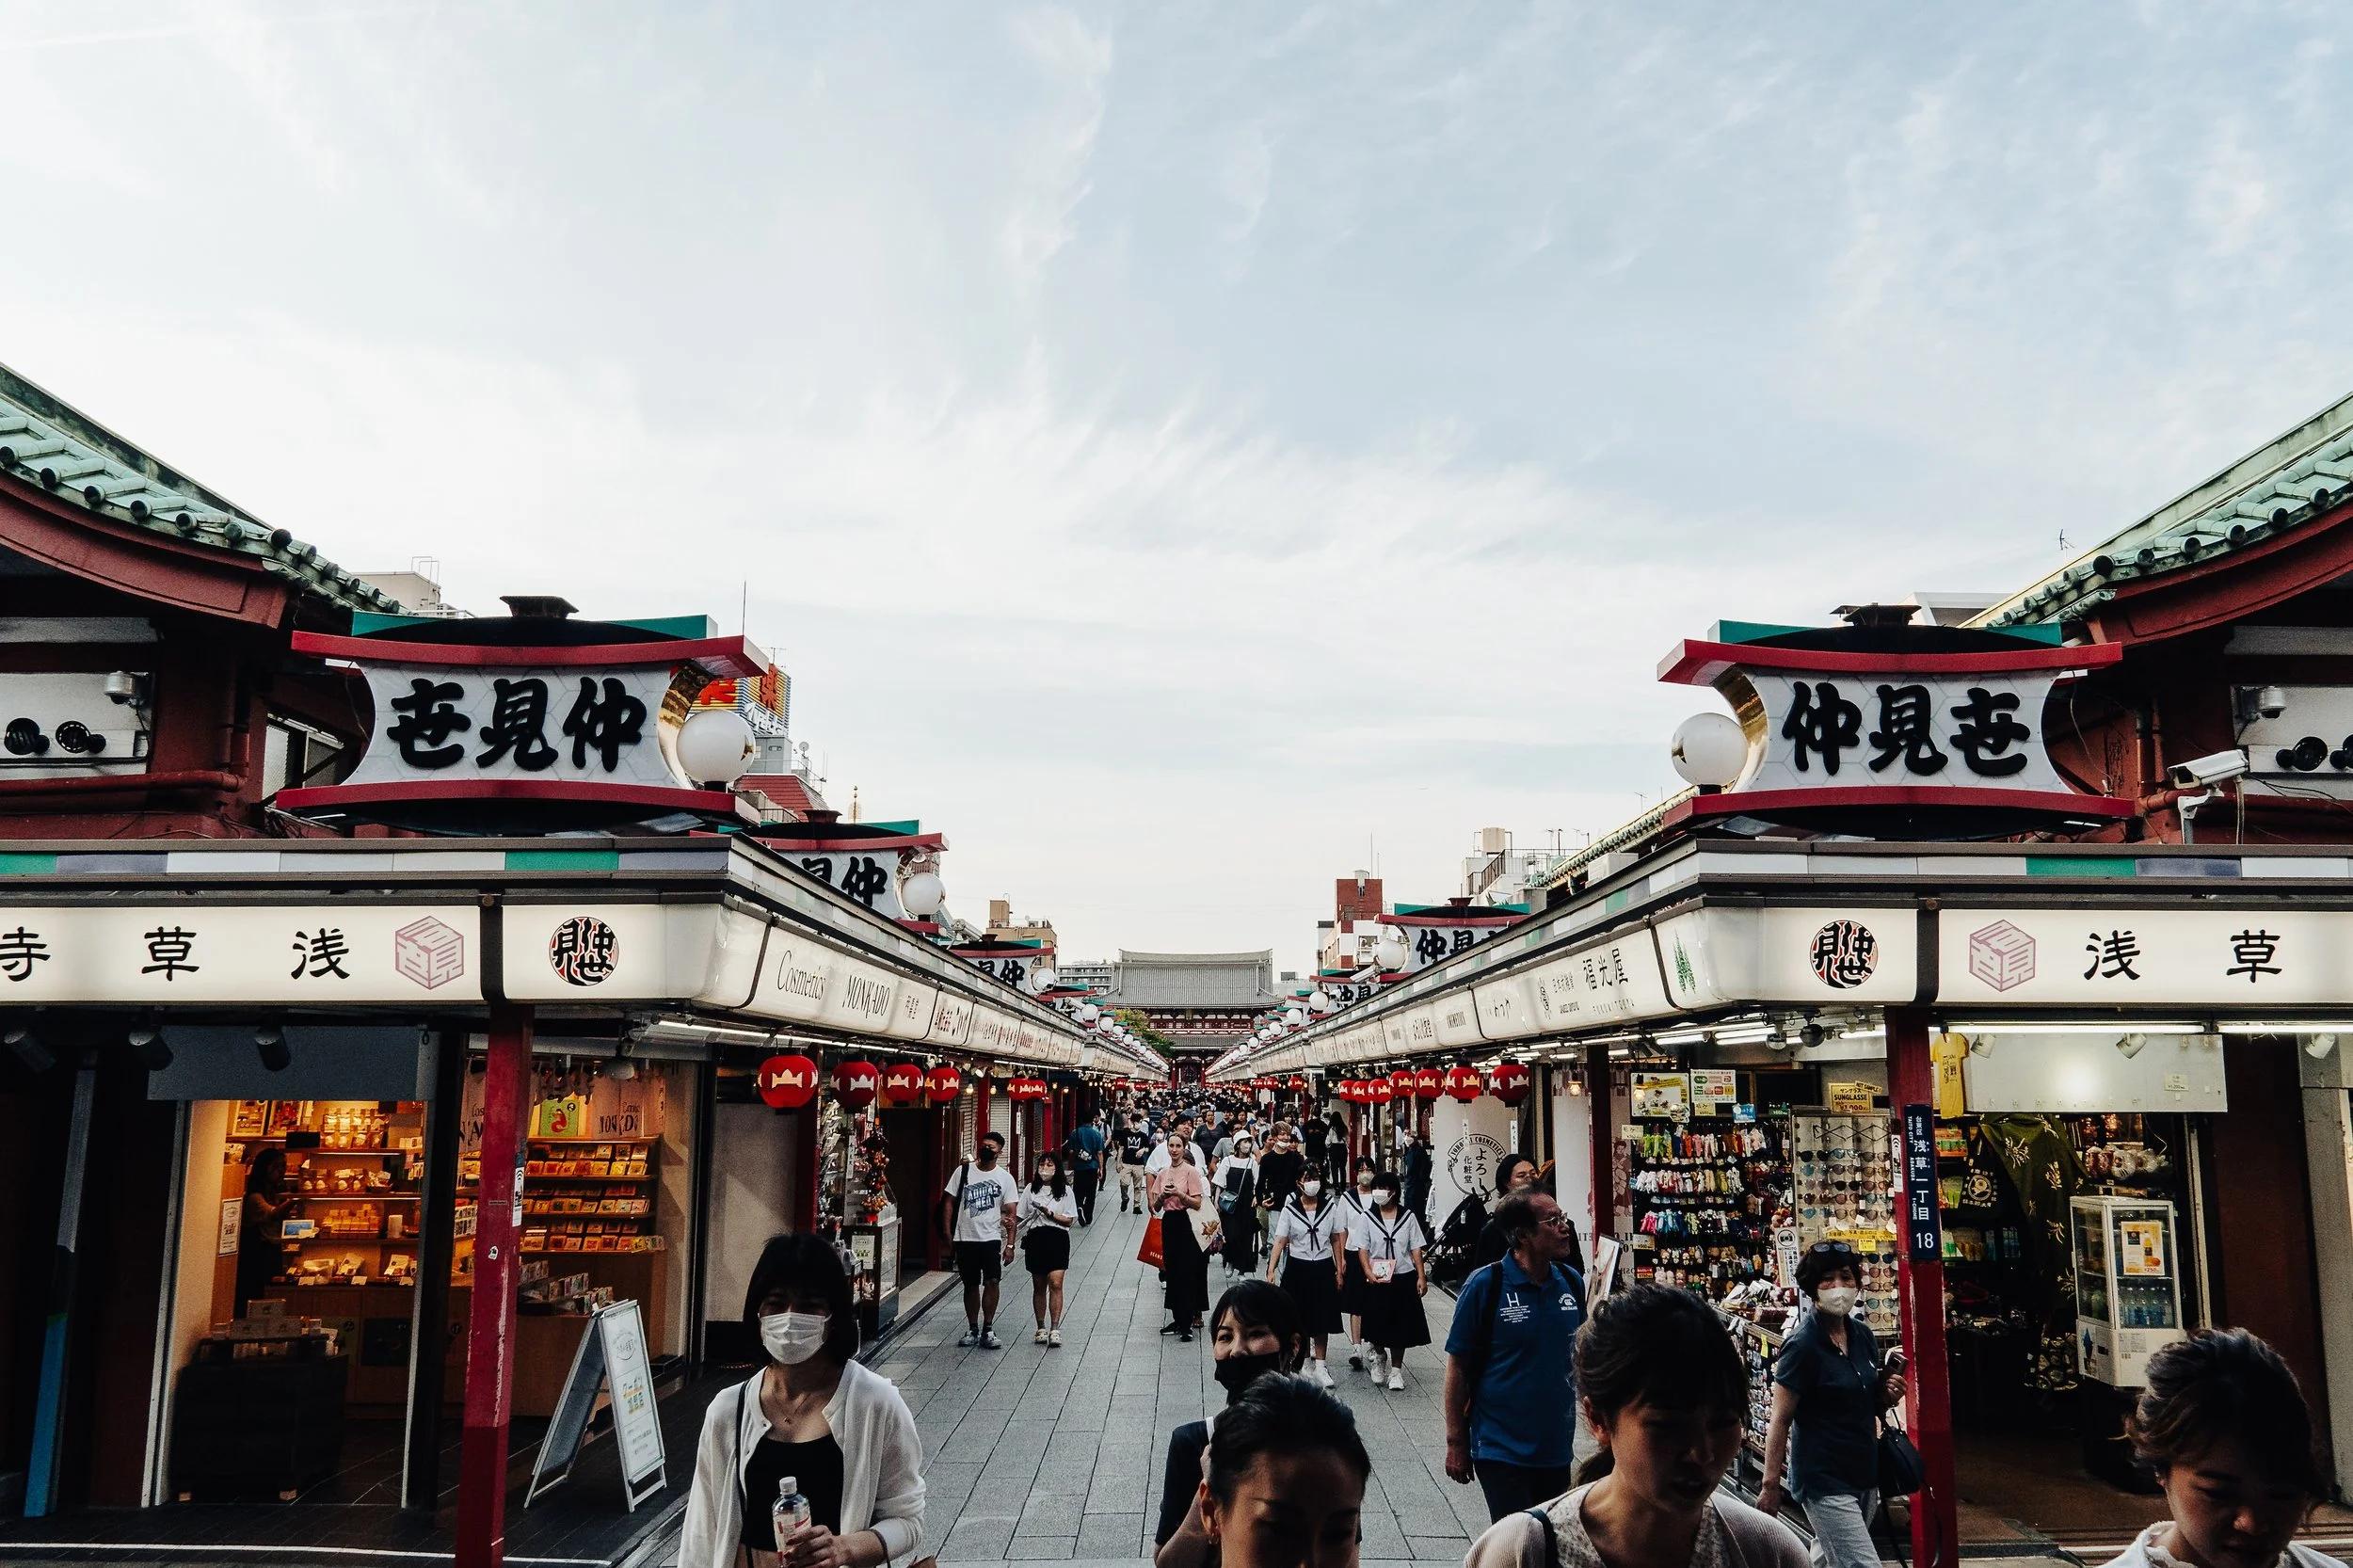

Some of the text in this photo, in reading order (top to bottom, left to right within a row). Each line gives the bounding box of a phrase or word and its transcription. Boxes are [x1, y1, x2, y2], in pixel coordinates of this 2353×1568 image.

[1781, 680, 2031, 776] 仲見世
[1416, 929, 1497, 964] 仲見
[2084, 930, 2281, 983] 浅草
[776, 951, 826, 1000] Cosmetics
[1582, 948, 1628, 990] 福光屋
[1475, 1136, 1503, 1156] COSMETICS
[1464, 1156, 1472, 1184] 化粧堂
[1913, 1140, 1929, 1221] 浅草一丁目
[968, 1185, 999, 1201] ADIDAS
[976, 1196, 992, 1208] NEO
[1916, 1232, 1934, 1249] 18
